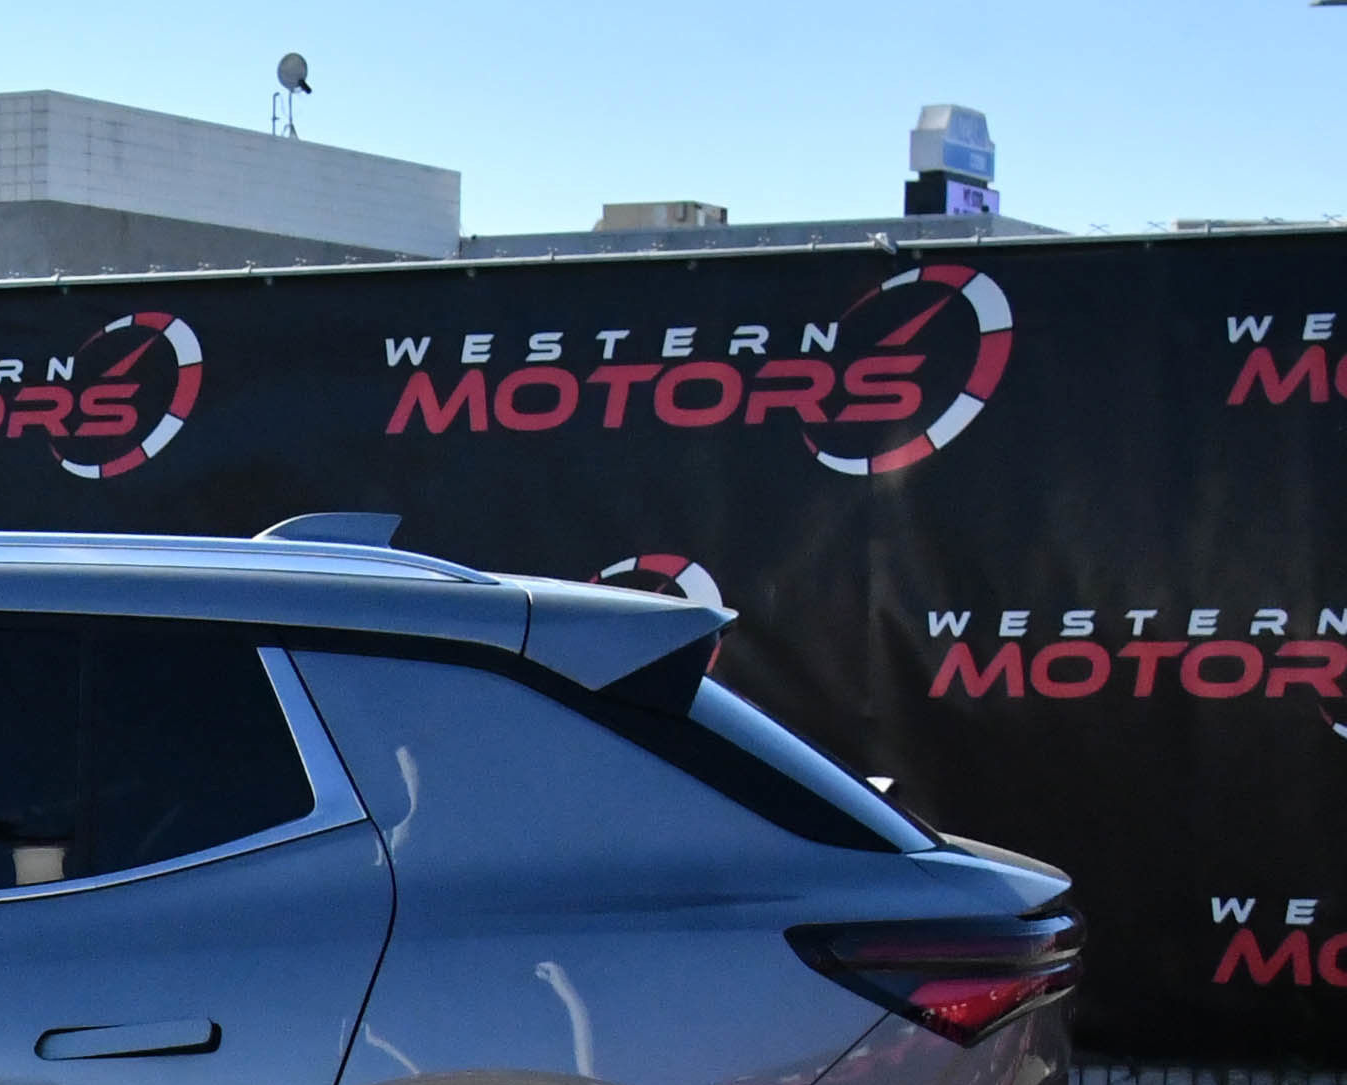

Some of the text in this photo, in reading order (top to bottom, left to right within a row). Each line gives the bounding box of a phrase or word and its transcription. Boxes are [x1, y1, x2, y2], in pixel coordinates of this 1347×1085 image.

[386, 322, 838, 366] WESTERN
[387, 354, 926, 434] MOTORS
[929, 608, 1347, 637] WESTERN
